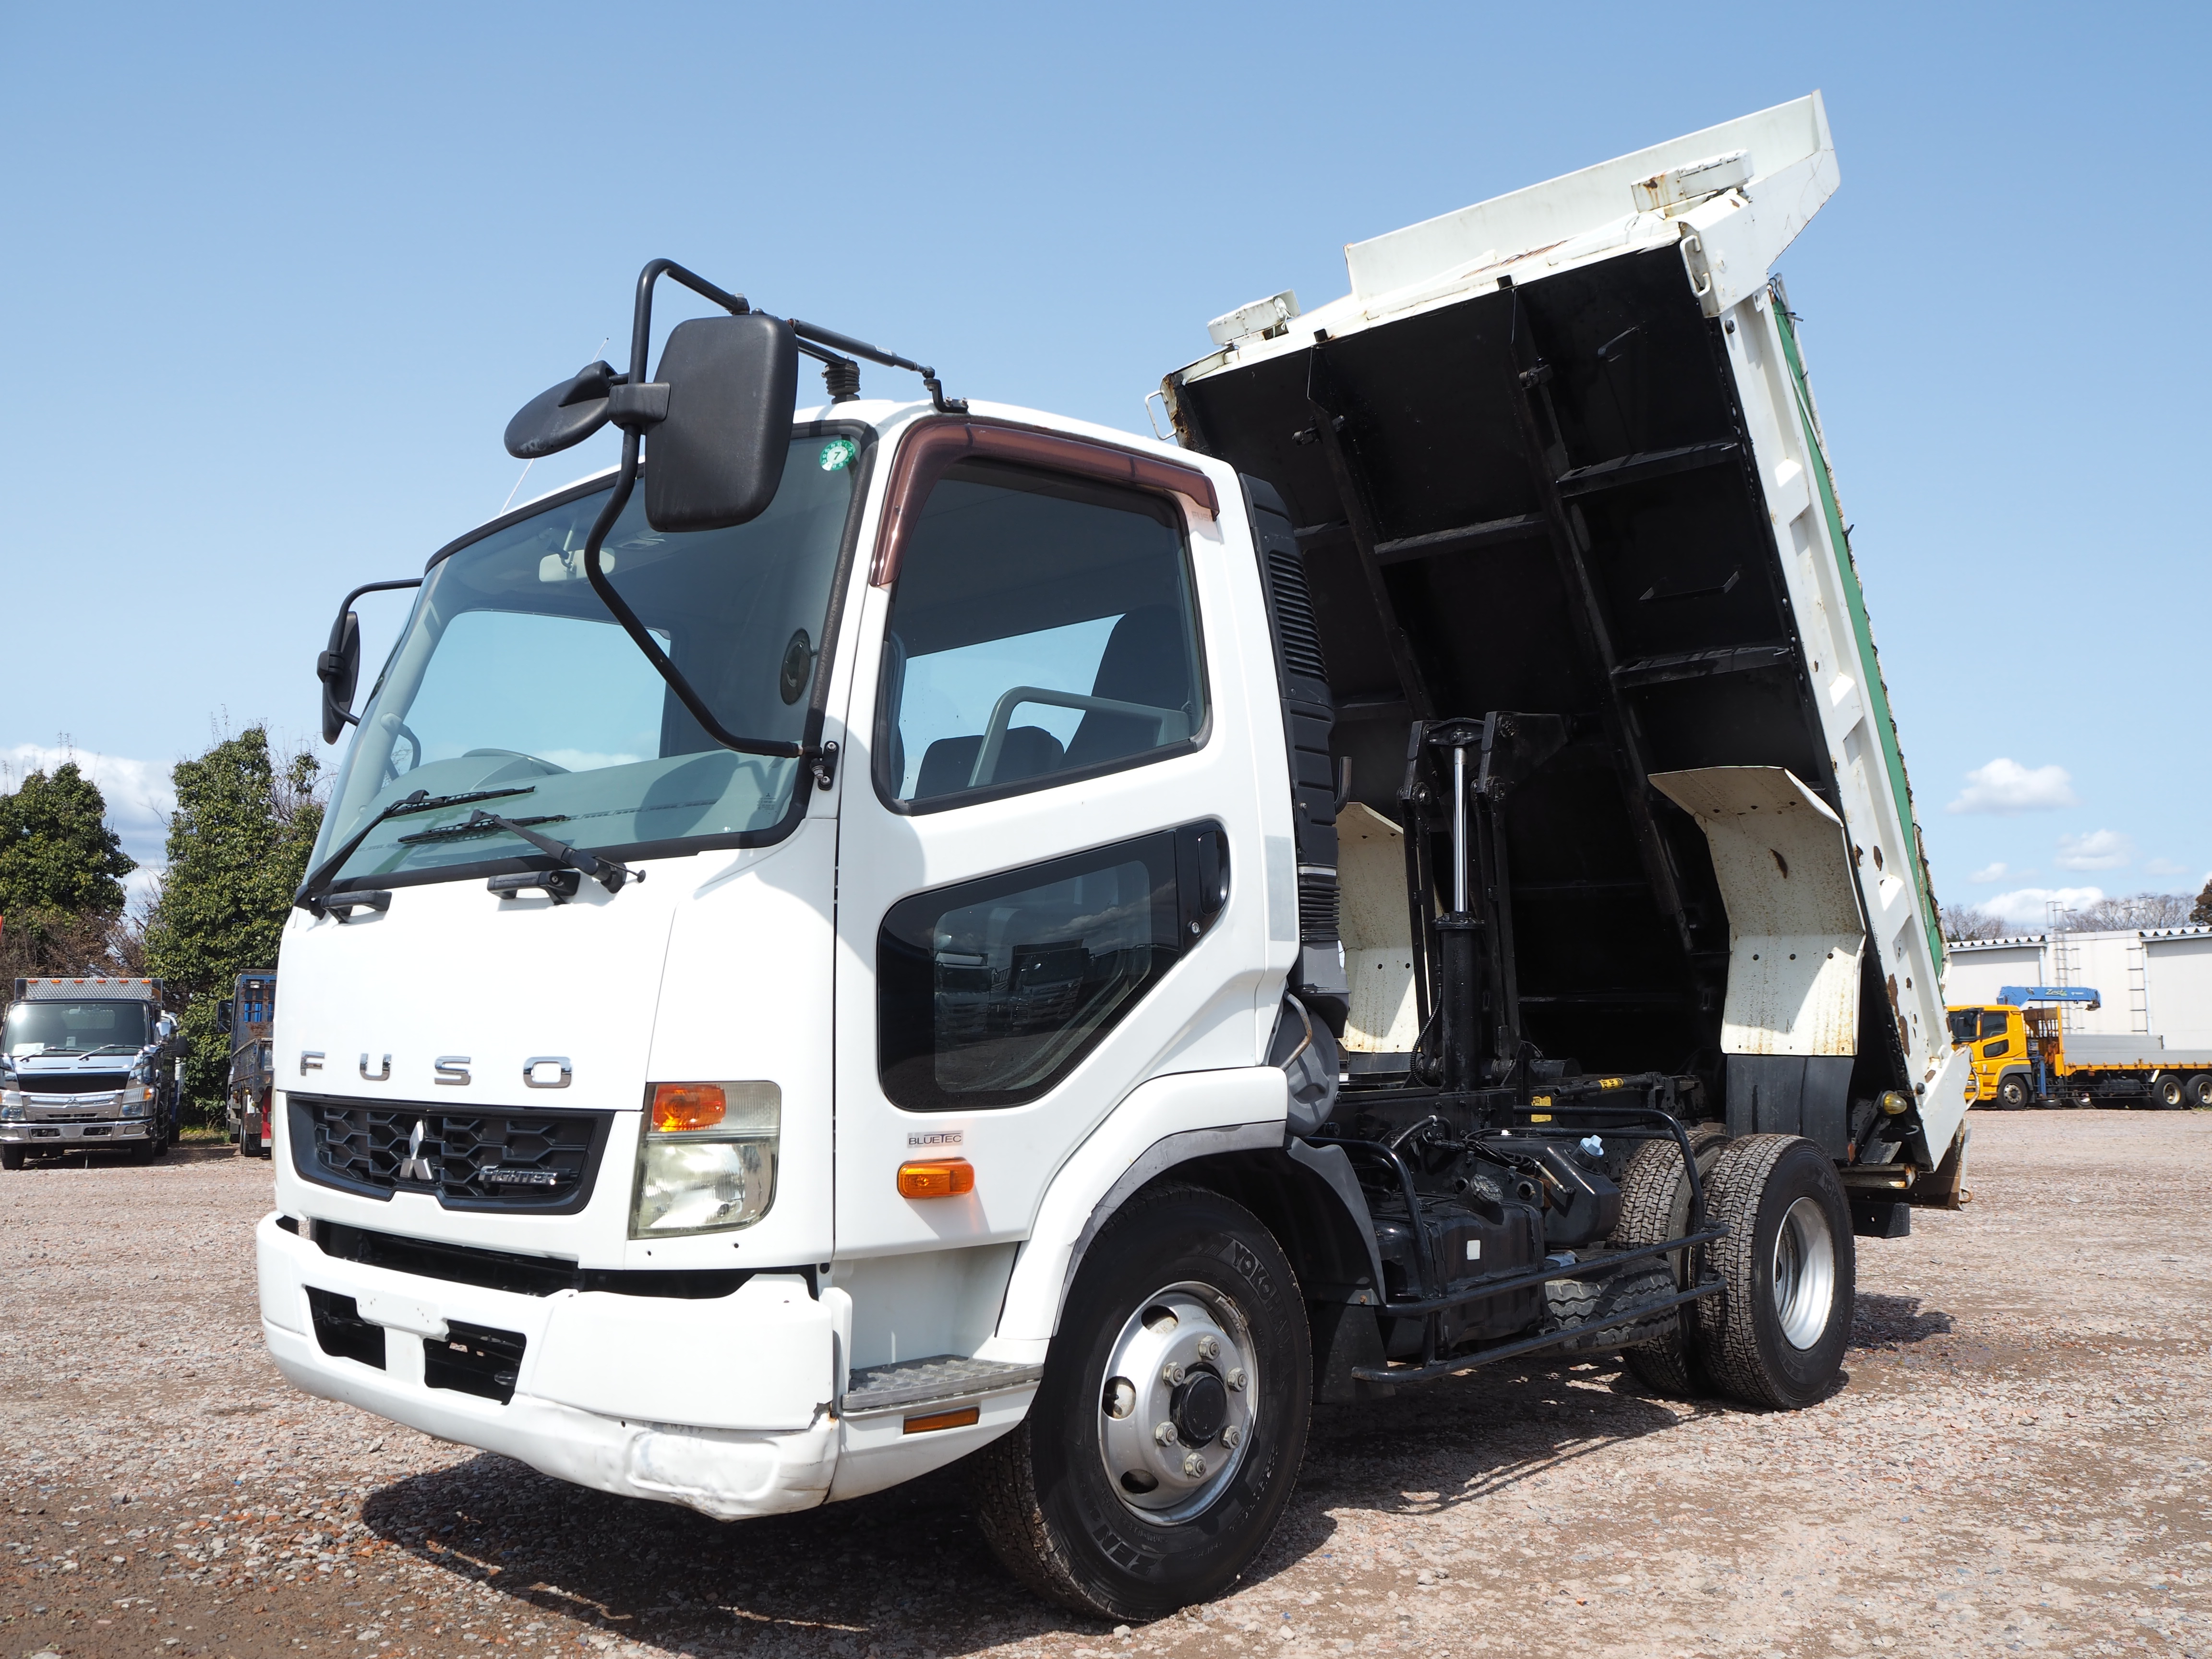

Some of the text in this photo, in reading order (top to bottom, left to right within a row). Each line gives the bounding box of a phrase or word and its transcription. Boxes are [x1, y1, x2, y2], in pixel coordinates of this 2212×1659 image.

[834, 452, 841, 460] 7
[301, 1051, 573, 1088] FUSO
[909, 1133, 962, 1145] BLUETEC
[1092, 1523, 1157, 1576] ZEN
